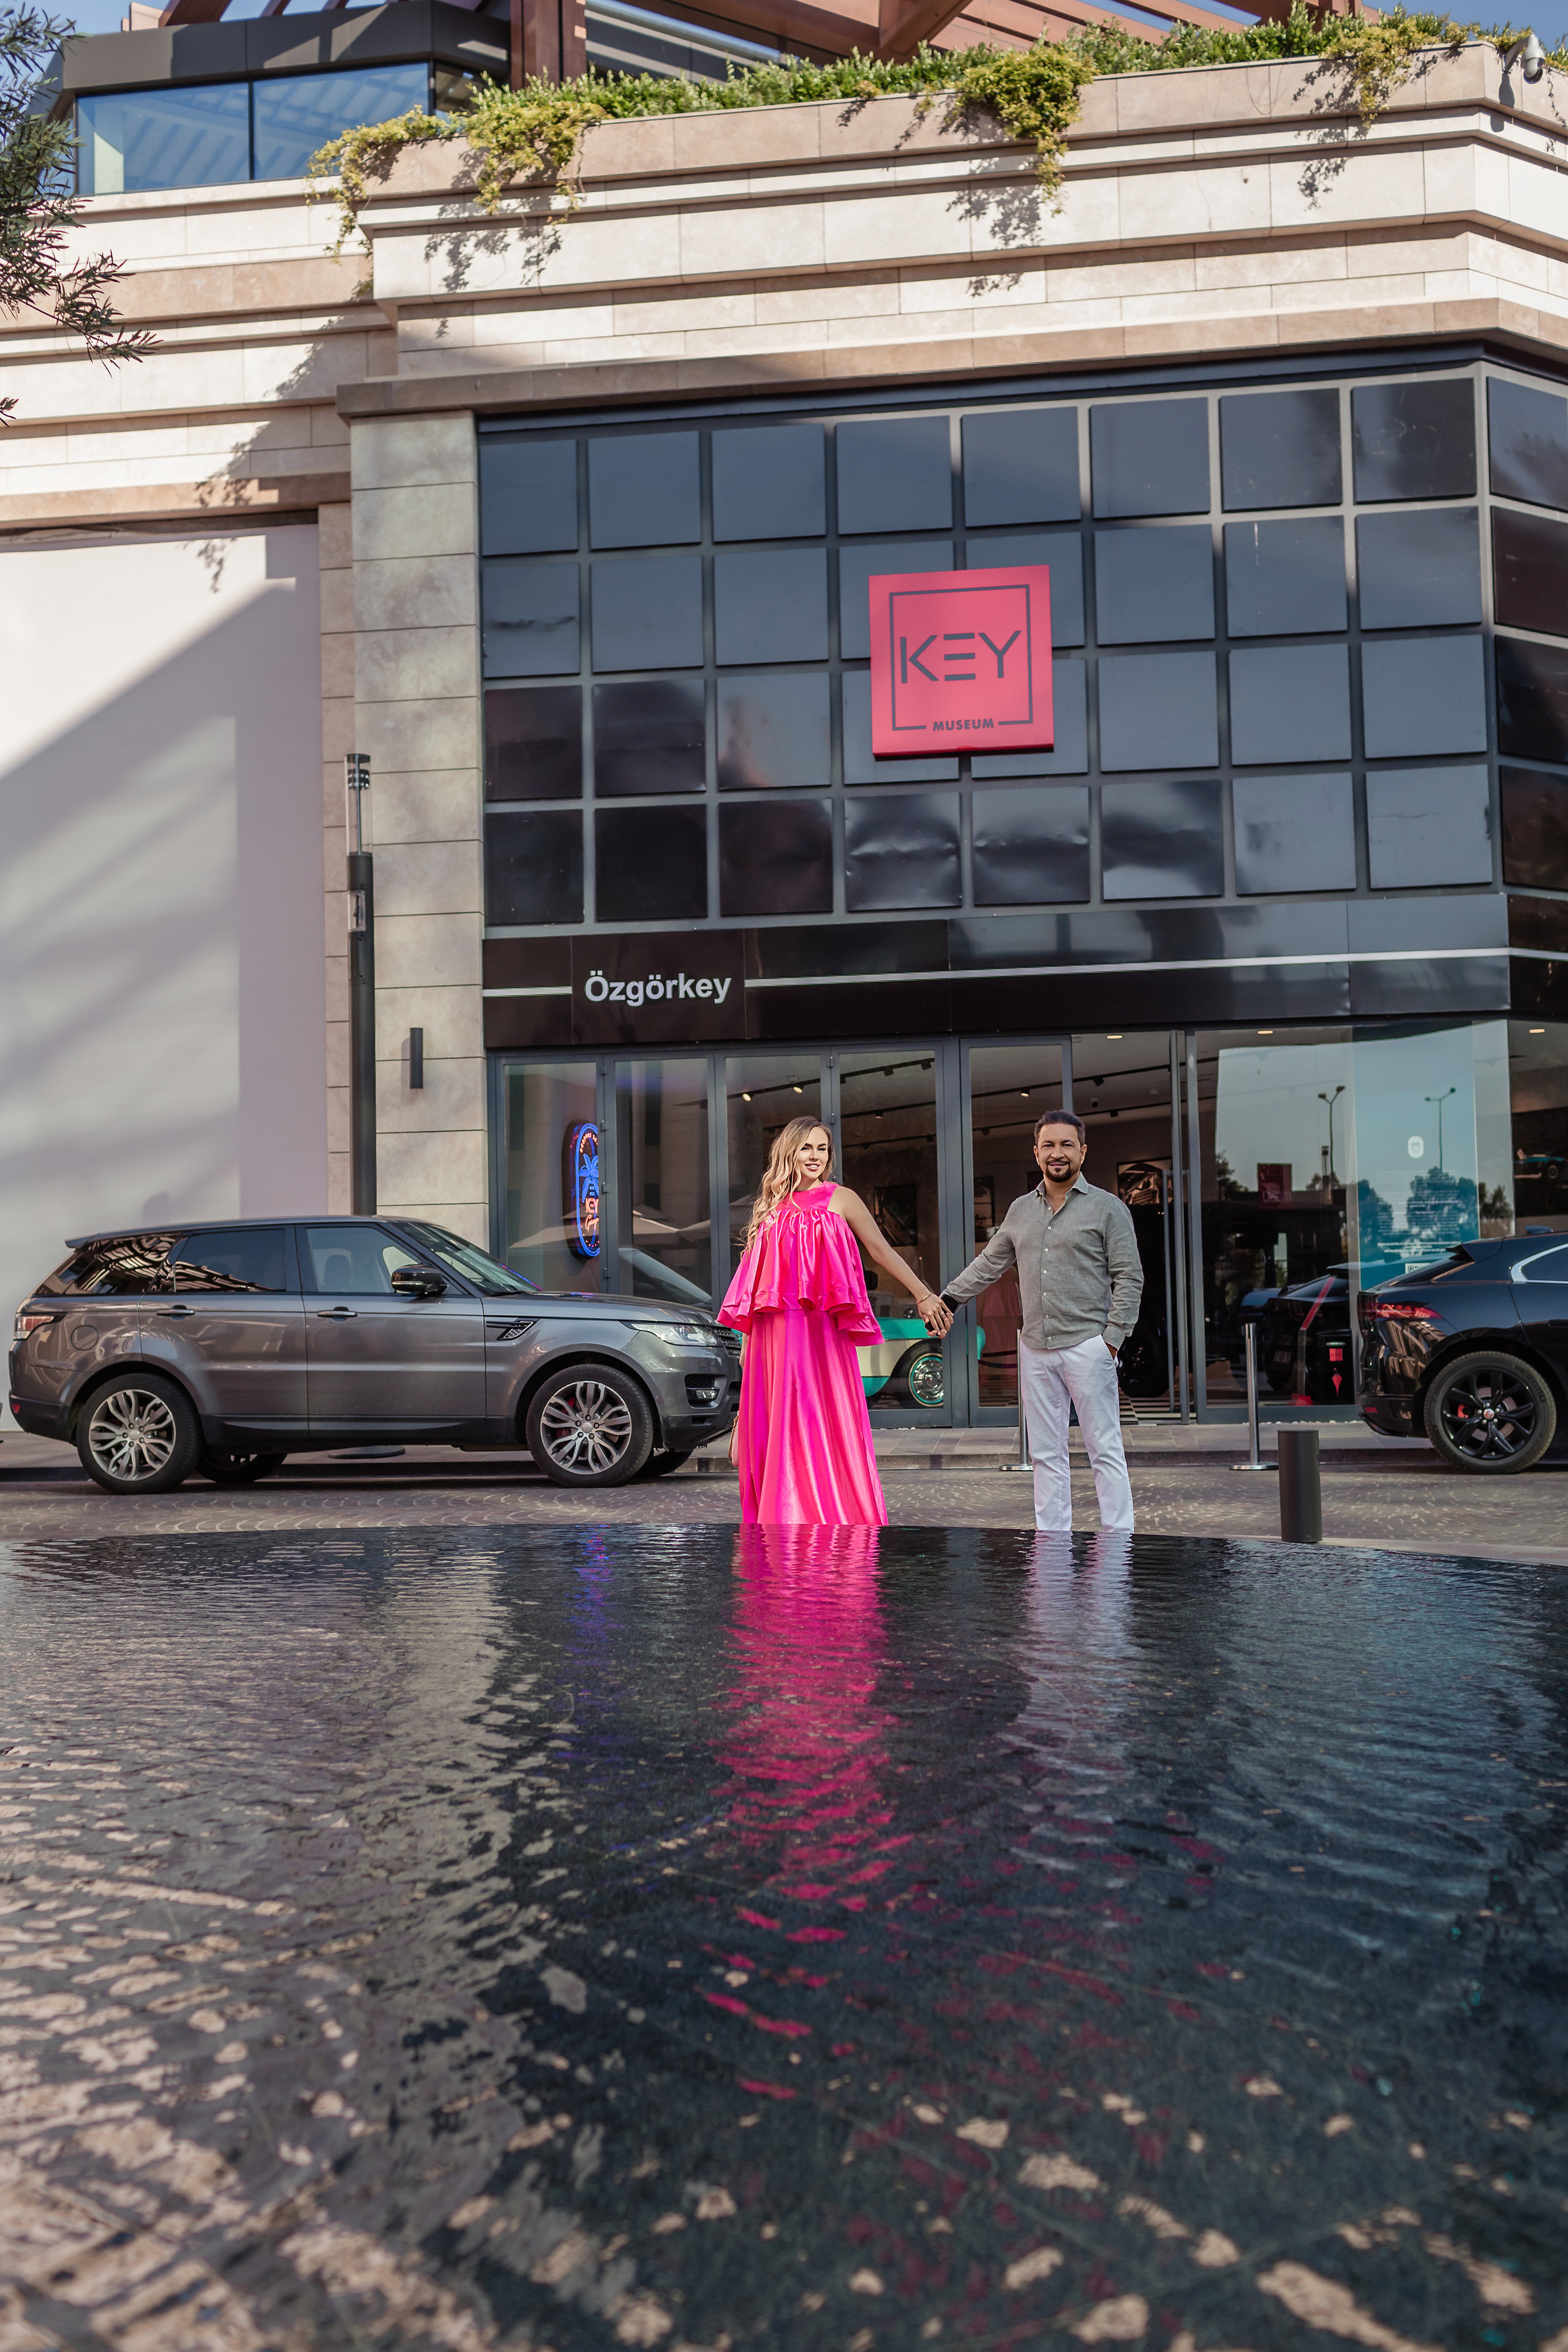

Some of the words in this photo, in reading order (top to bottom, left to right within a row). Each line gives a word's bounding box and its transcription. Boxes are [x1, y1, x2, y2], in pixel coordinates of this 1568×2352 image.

[900, 630, 1022, 684] KEY
[933, 718, 994, 731] MUSEUM
[585, 970, 731, 1006] Özgörkey
